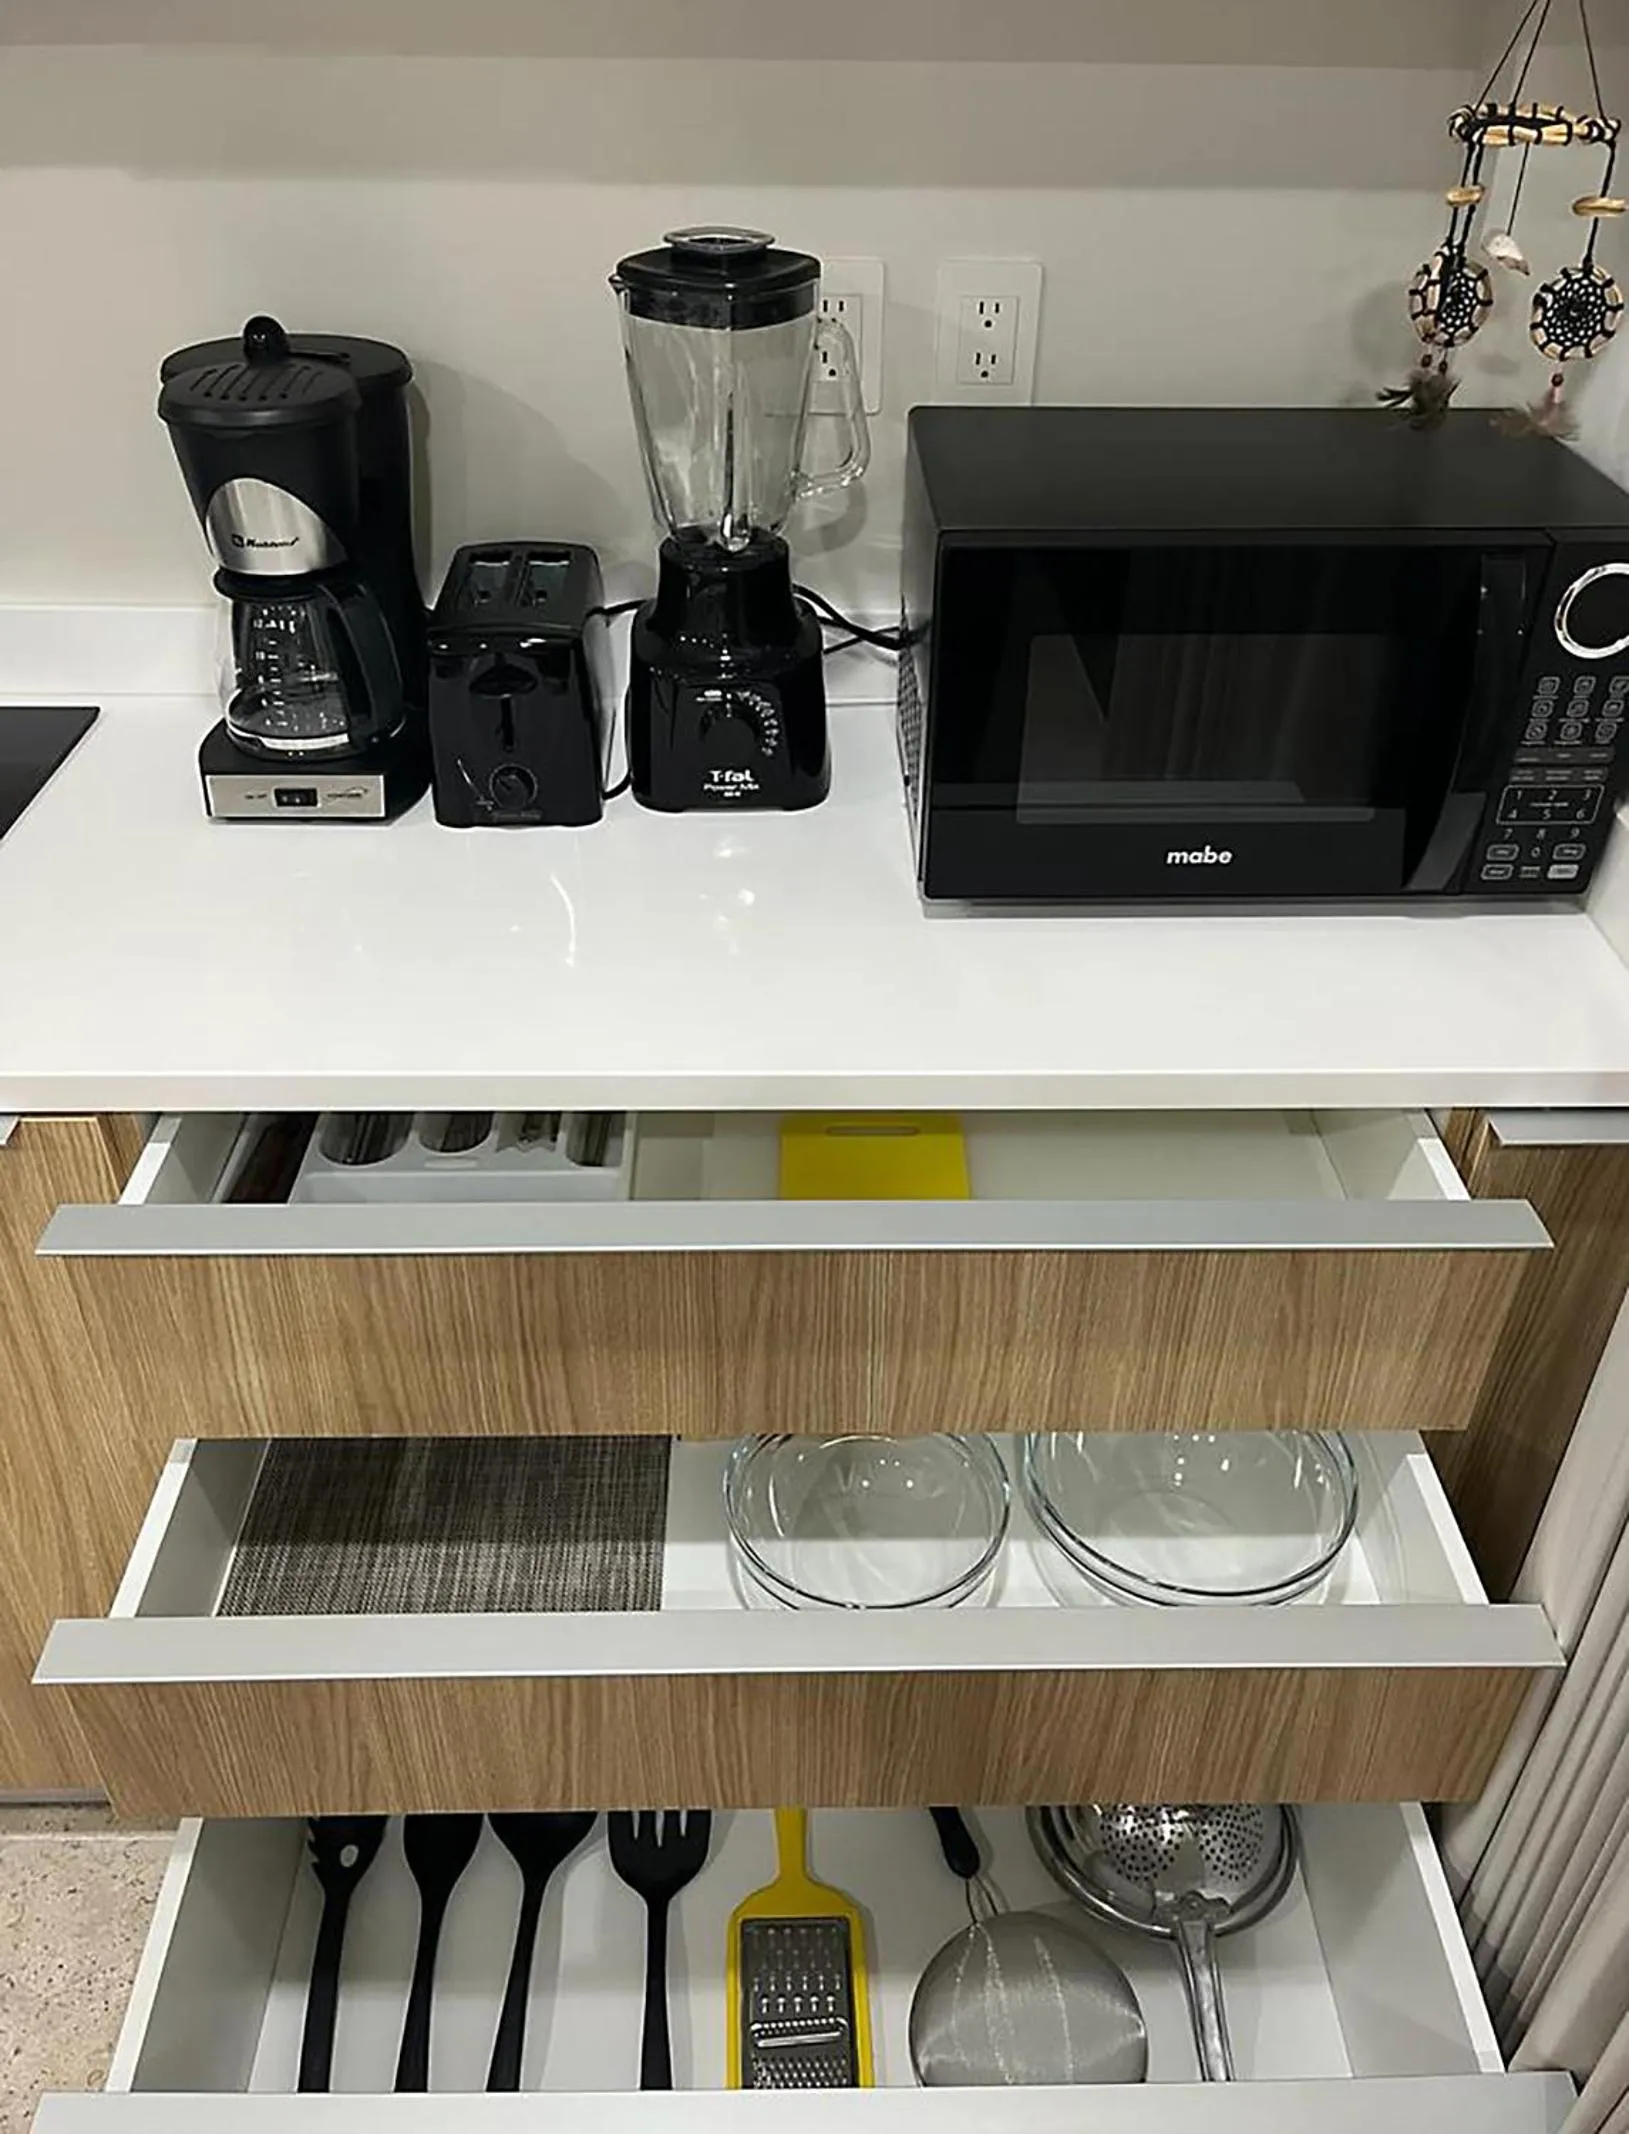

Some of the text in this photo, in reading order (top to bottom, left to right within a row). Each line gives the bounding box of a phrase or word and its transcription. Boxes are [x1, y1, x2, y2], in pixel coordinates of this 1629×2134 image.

[1548, 790, 1557, 800] 2
[1584, 790, 1591, 801] 3
[1543, 809, 1551, 820] 5
[1576, 809, 1585, 819] 6
[1504, 828, 1513, 839] 7
[1571, 828, 1580, 838] 9
[1166, 845, 1233, 864] mabe
[1531, 847, 1541, 858] 0
